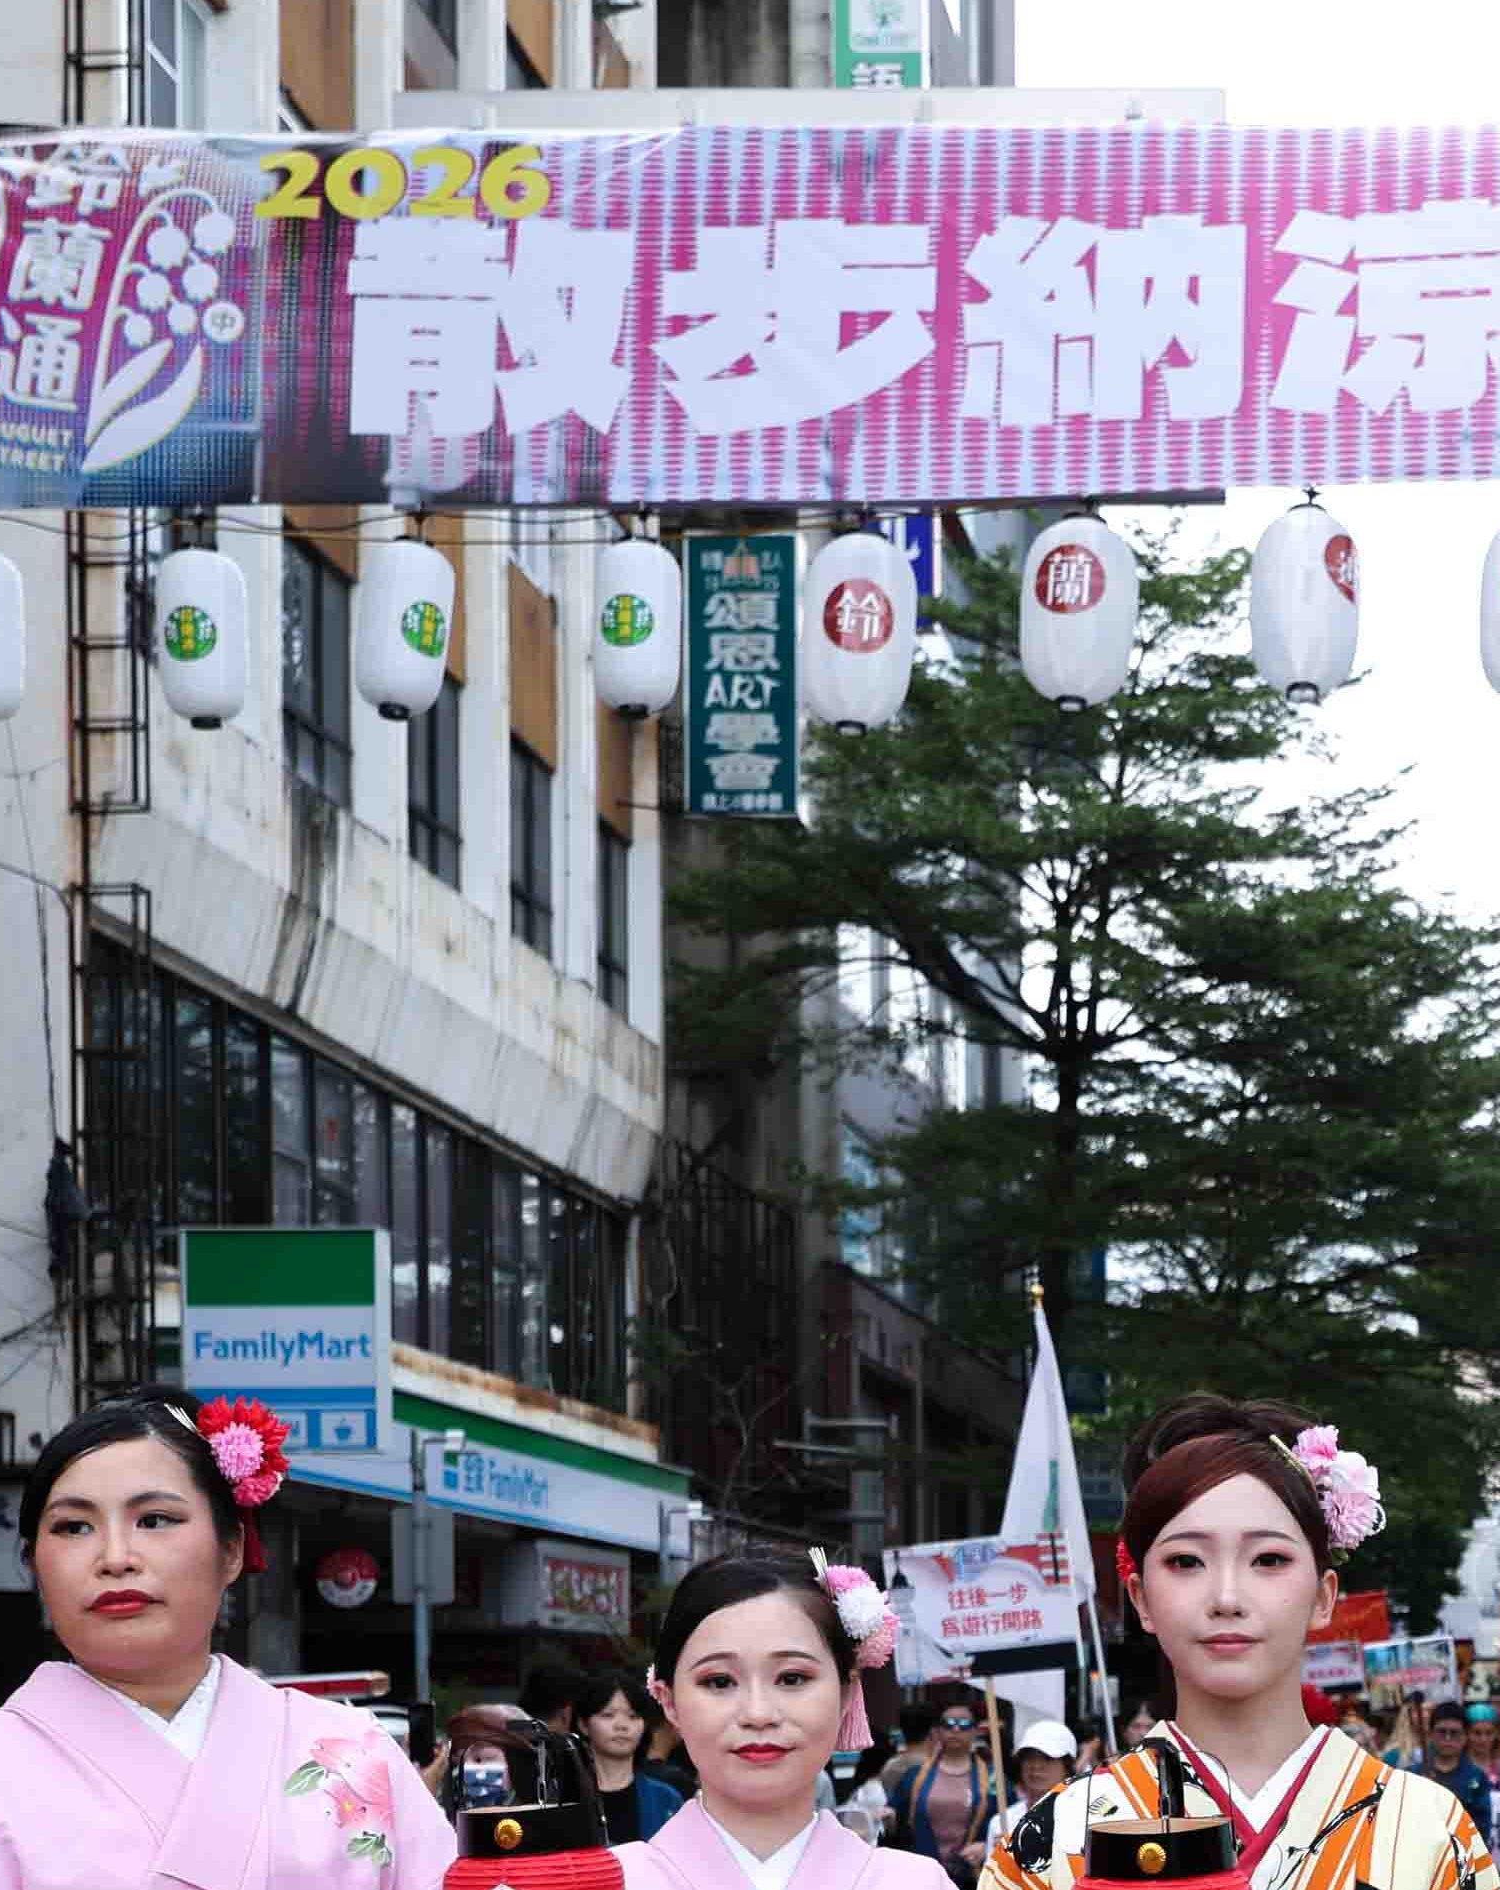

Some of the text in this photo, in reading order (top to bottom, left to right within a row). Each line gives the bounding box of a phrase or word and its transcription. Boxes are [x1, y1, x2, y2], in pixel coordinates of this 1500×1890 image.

[256, 147, 552, 221] 2026
[1049, 553, 1094, 607] 蘭
[837, 589, 882, 641] 鈴
[194, 1329, 372, 1368] FamilyMart
[948, 1582, 1029, 1610] 往後一步
